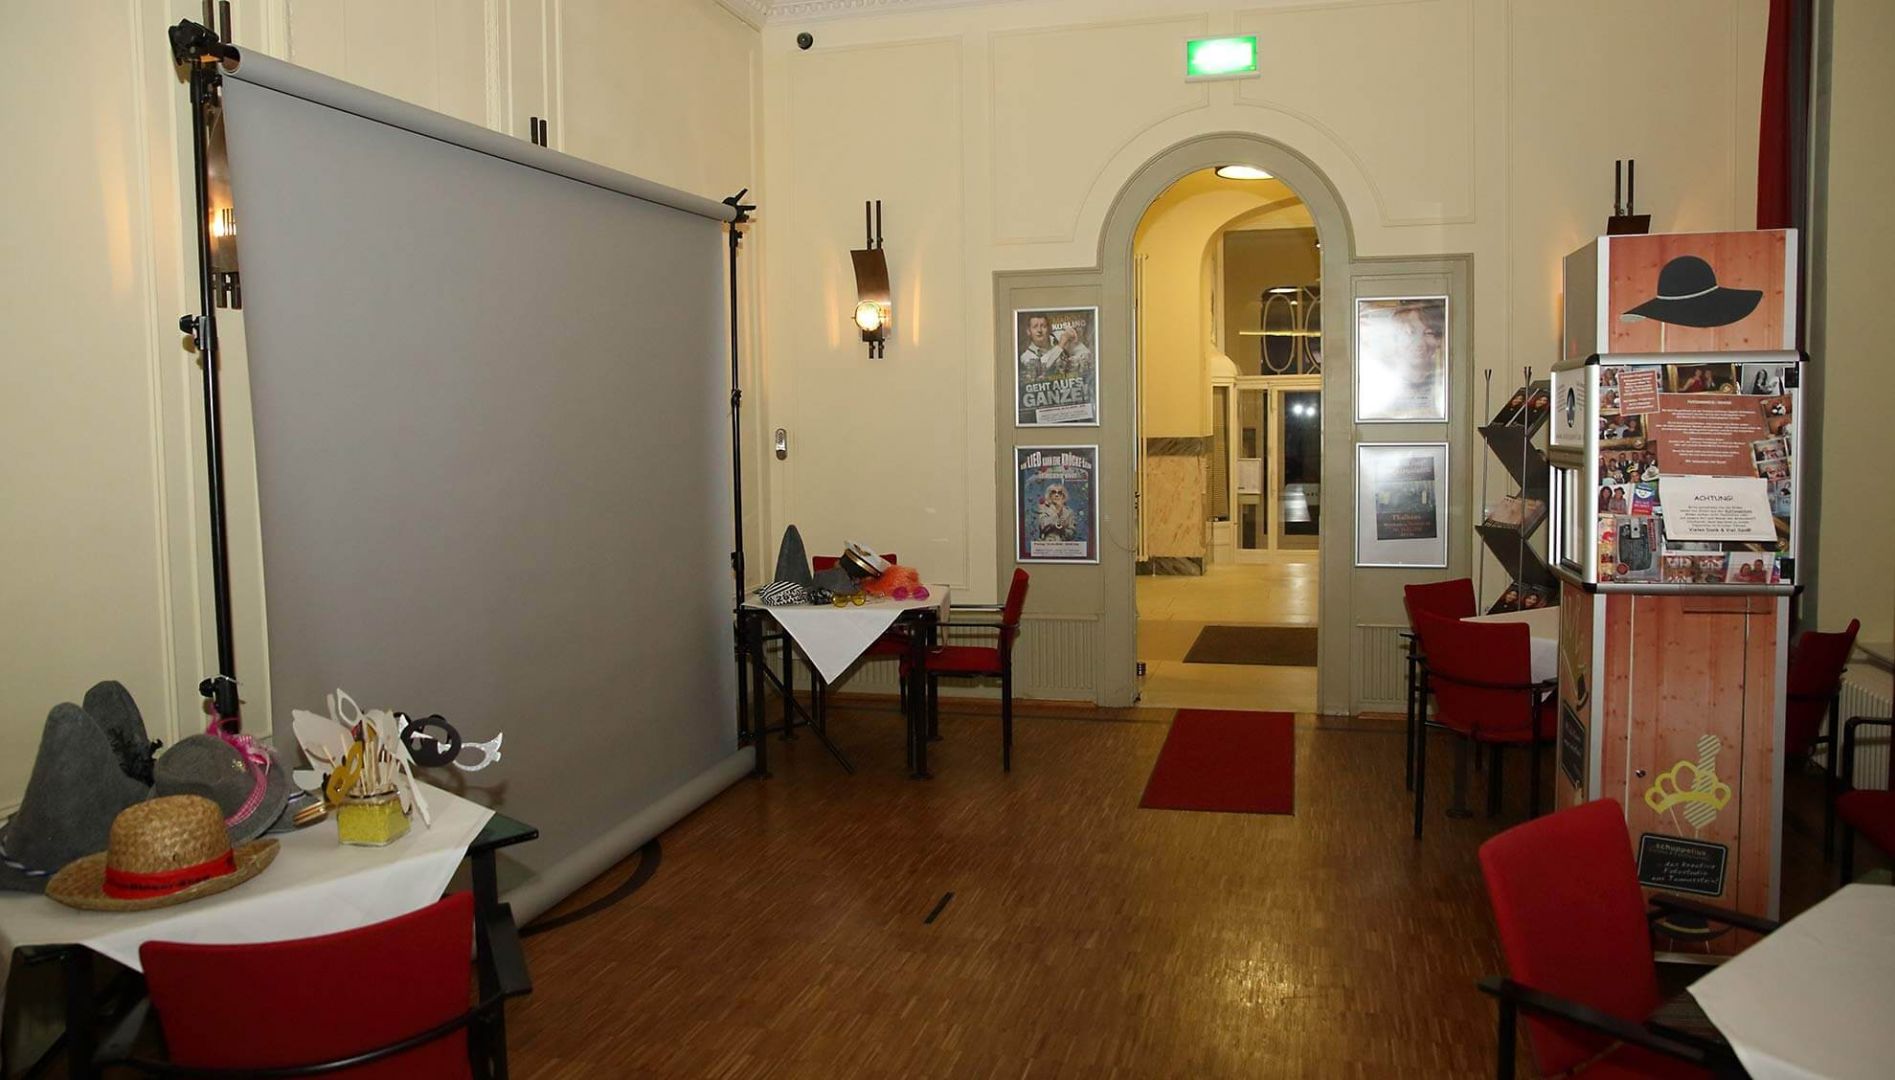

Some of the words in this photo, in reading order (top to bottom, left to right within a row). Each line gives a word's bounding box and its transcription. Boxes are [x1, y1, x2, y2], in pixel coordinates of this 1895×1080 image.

[1025, 382, 1051, 393] GEHT
[1052, 377, 1084, 390] AUFS
[1022, 383, 1090, 407] GANZE!
[1027, 451, 1042, 468] LIED
